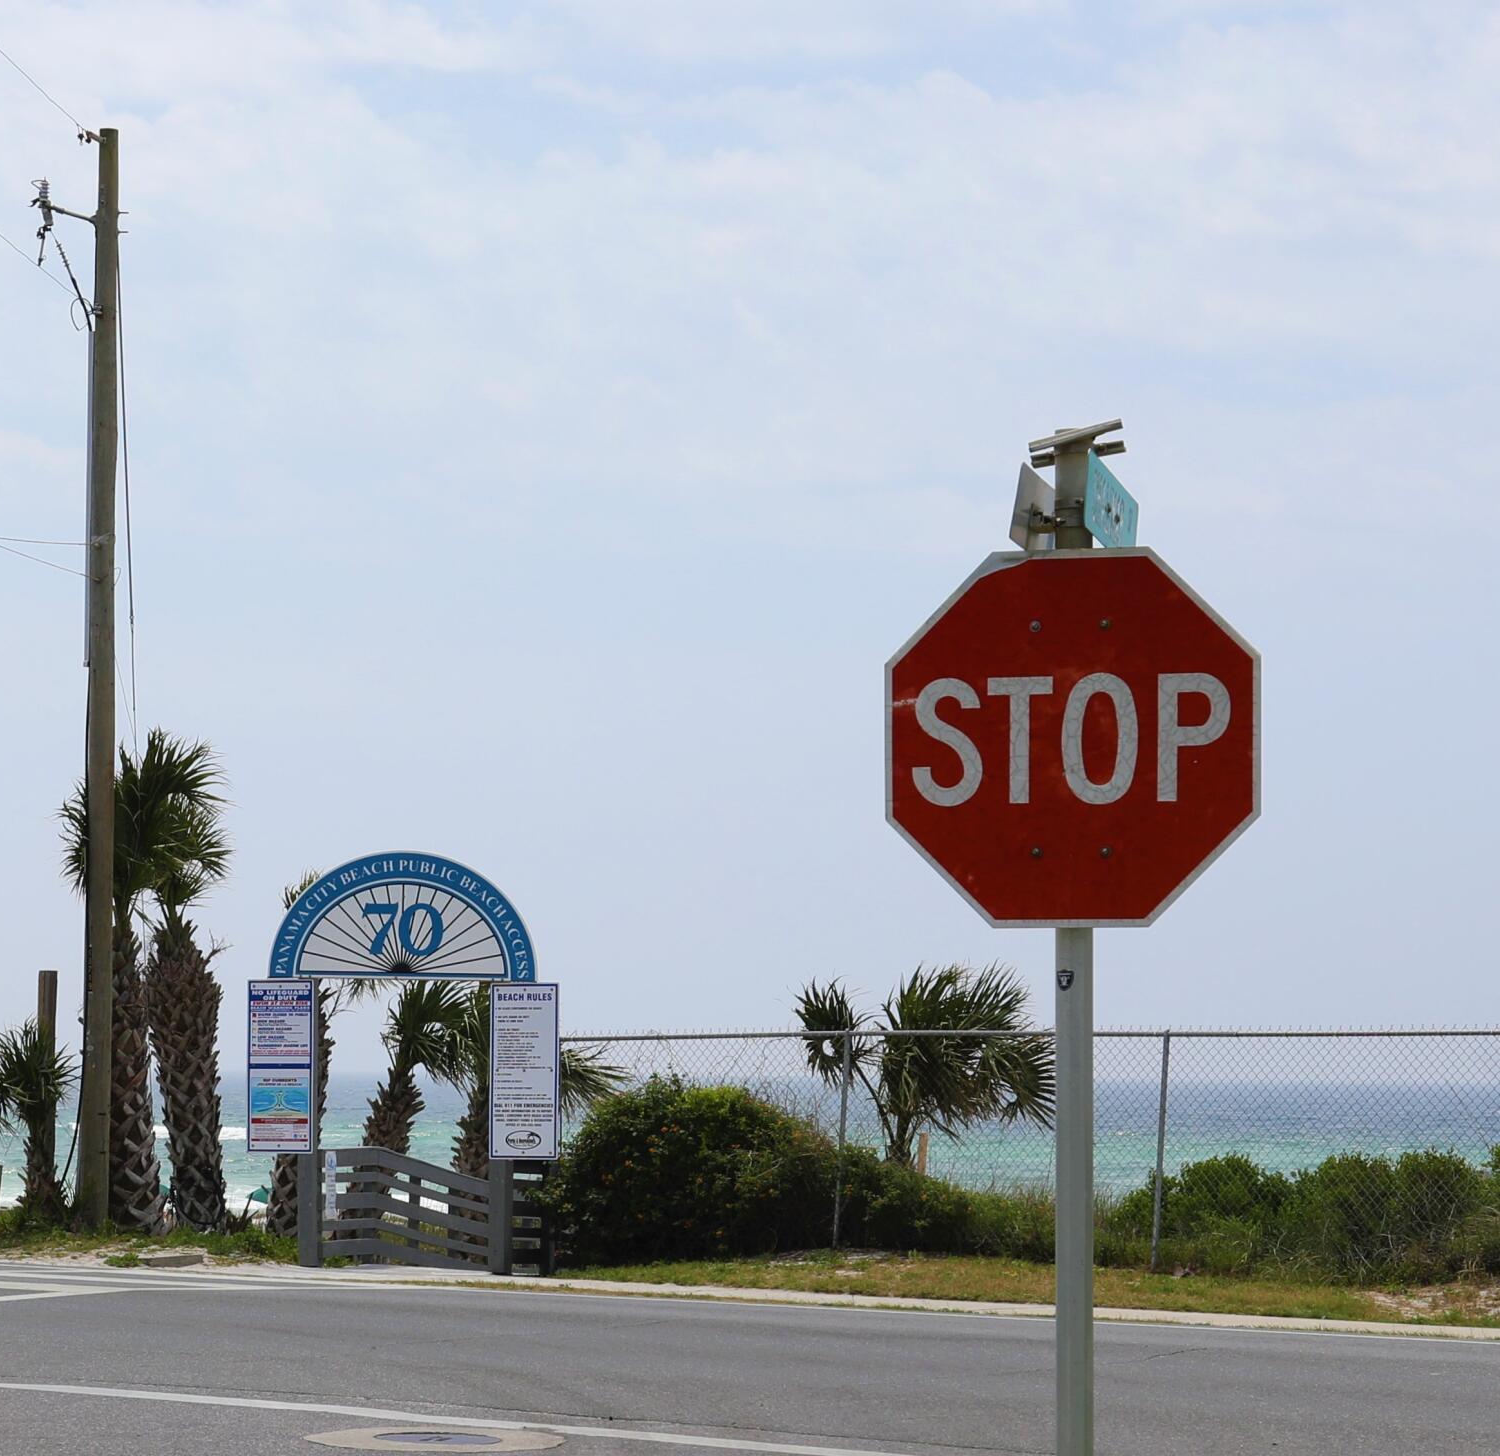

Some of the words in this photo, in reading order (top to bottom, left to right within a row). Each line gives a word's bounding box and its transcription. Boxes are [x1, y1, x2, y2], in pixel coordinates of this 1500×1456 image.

[911, 671, 1232, 807] STOP
[275, 910, 309, 974] PANAMA
[306, 878, 339, 910] CITY
[340, 860, 394, 885] BEACH
[399, 859, 458, 882] PUBLIC
[459, 875, 507, 918] BEACH
[501, 919, 529, 979] ACCESS
[362, 902, 444, 957] 70
[497, 993, 524, 1001] BEACH
[527, 992, 553, 1001] RULES
